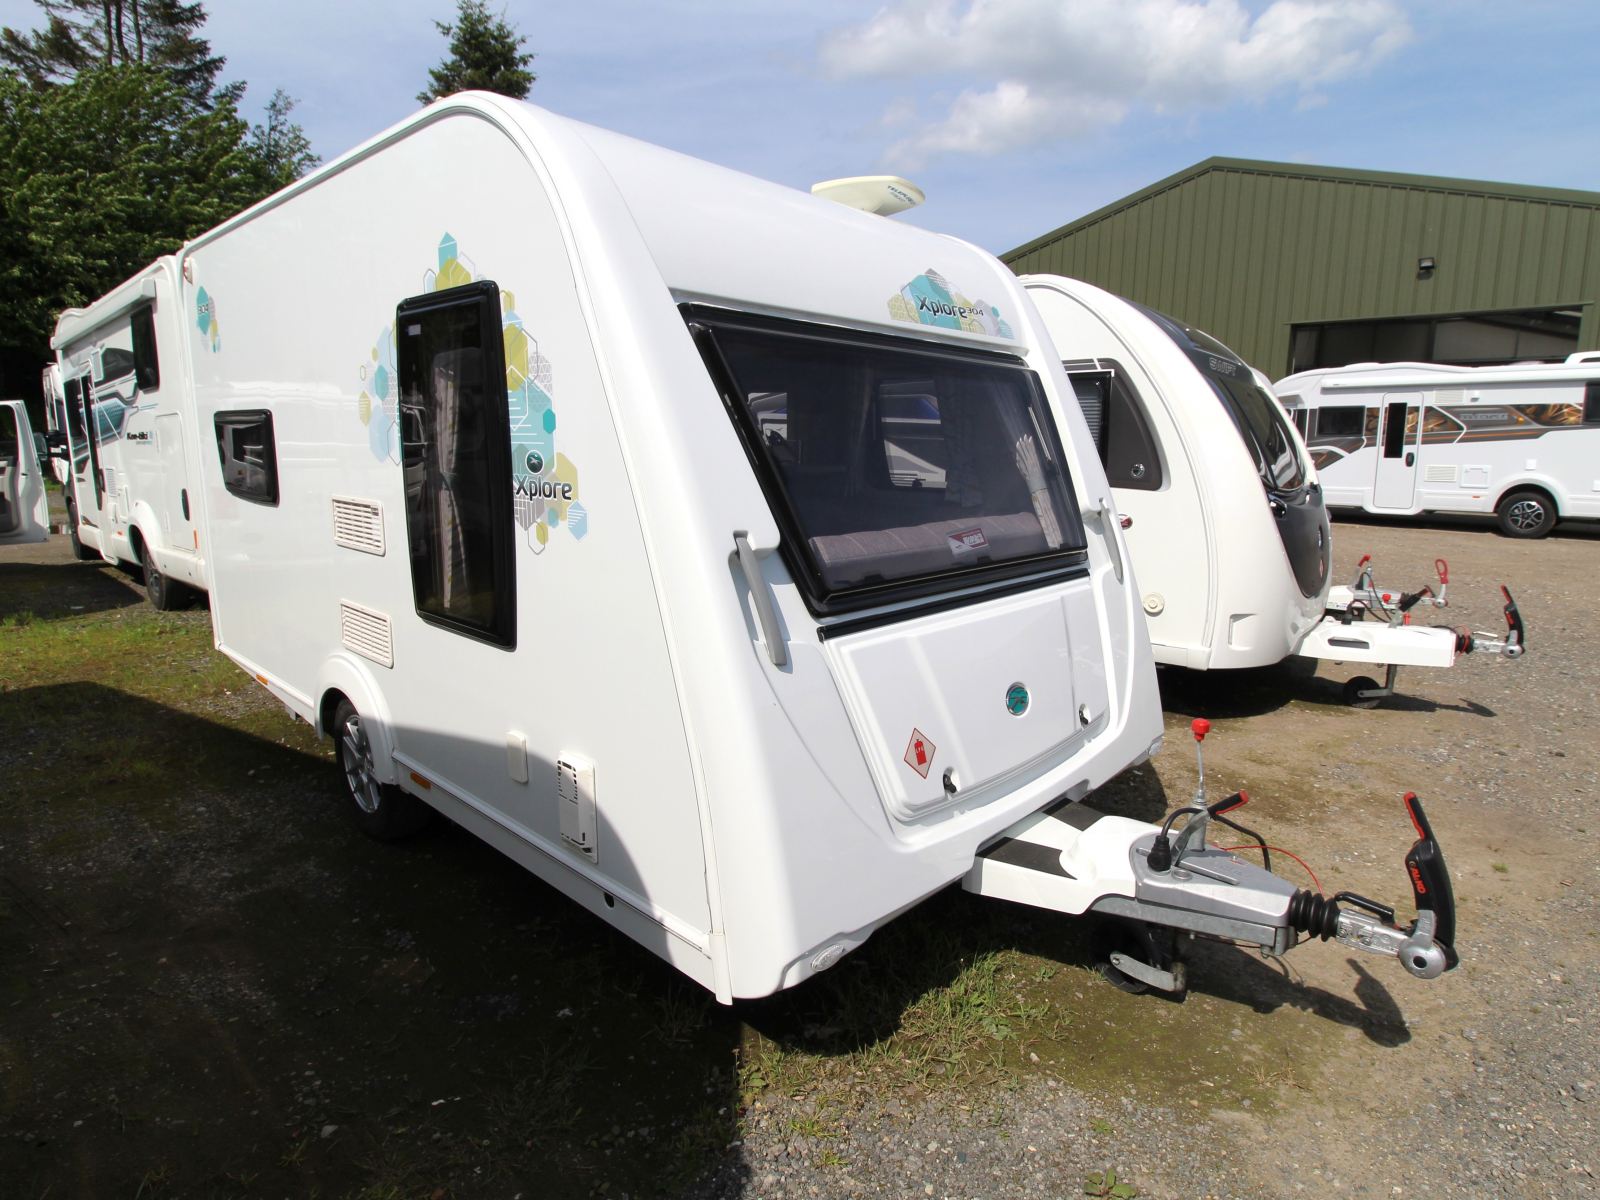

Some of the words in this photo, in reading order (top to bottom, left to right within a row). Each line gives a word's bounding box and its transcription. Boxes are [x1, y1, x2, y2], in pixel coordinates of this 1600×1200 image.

[198, 302, 209, 315] 304
[915, 295, 968, 318] Xplore
[967, 307, 984, 316] 304
[1209, 357, 1236, 376] SWIFT
[514, 474, 573, 501] Xplore
